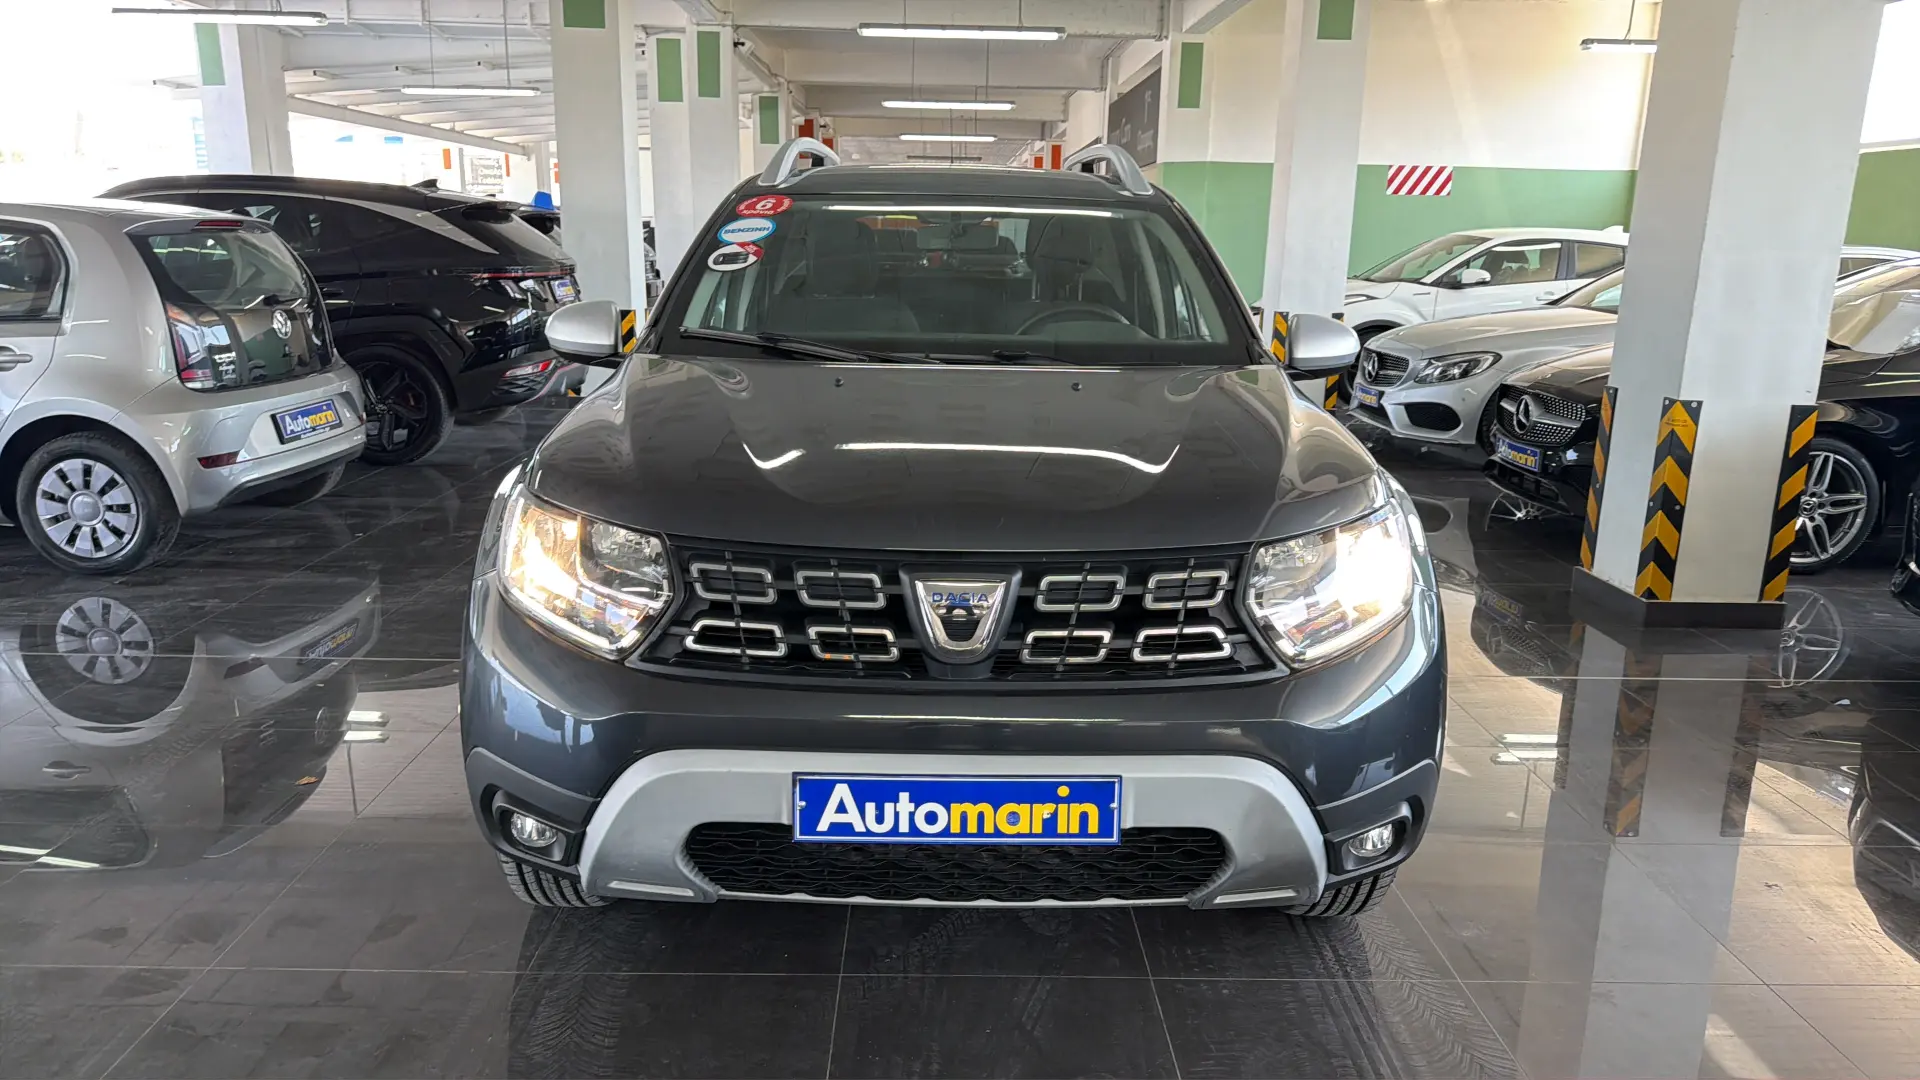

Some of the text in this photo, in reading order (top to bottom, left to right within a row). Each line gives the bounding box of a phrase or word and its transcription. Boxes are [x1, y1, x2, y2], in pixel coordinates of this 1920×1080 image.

[755, 199, 776, 209] 6
[931, 592, 990, 603] DACIA
[816, 783, 1098, 835] Automarin
